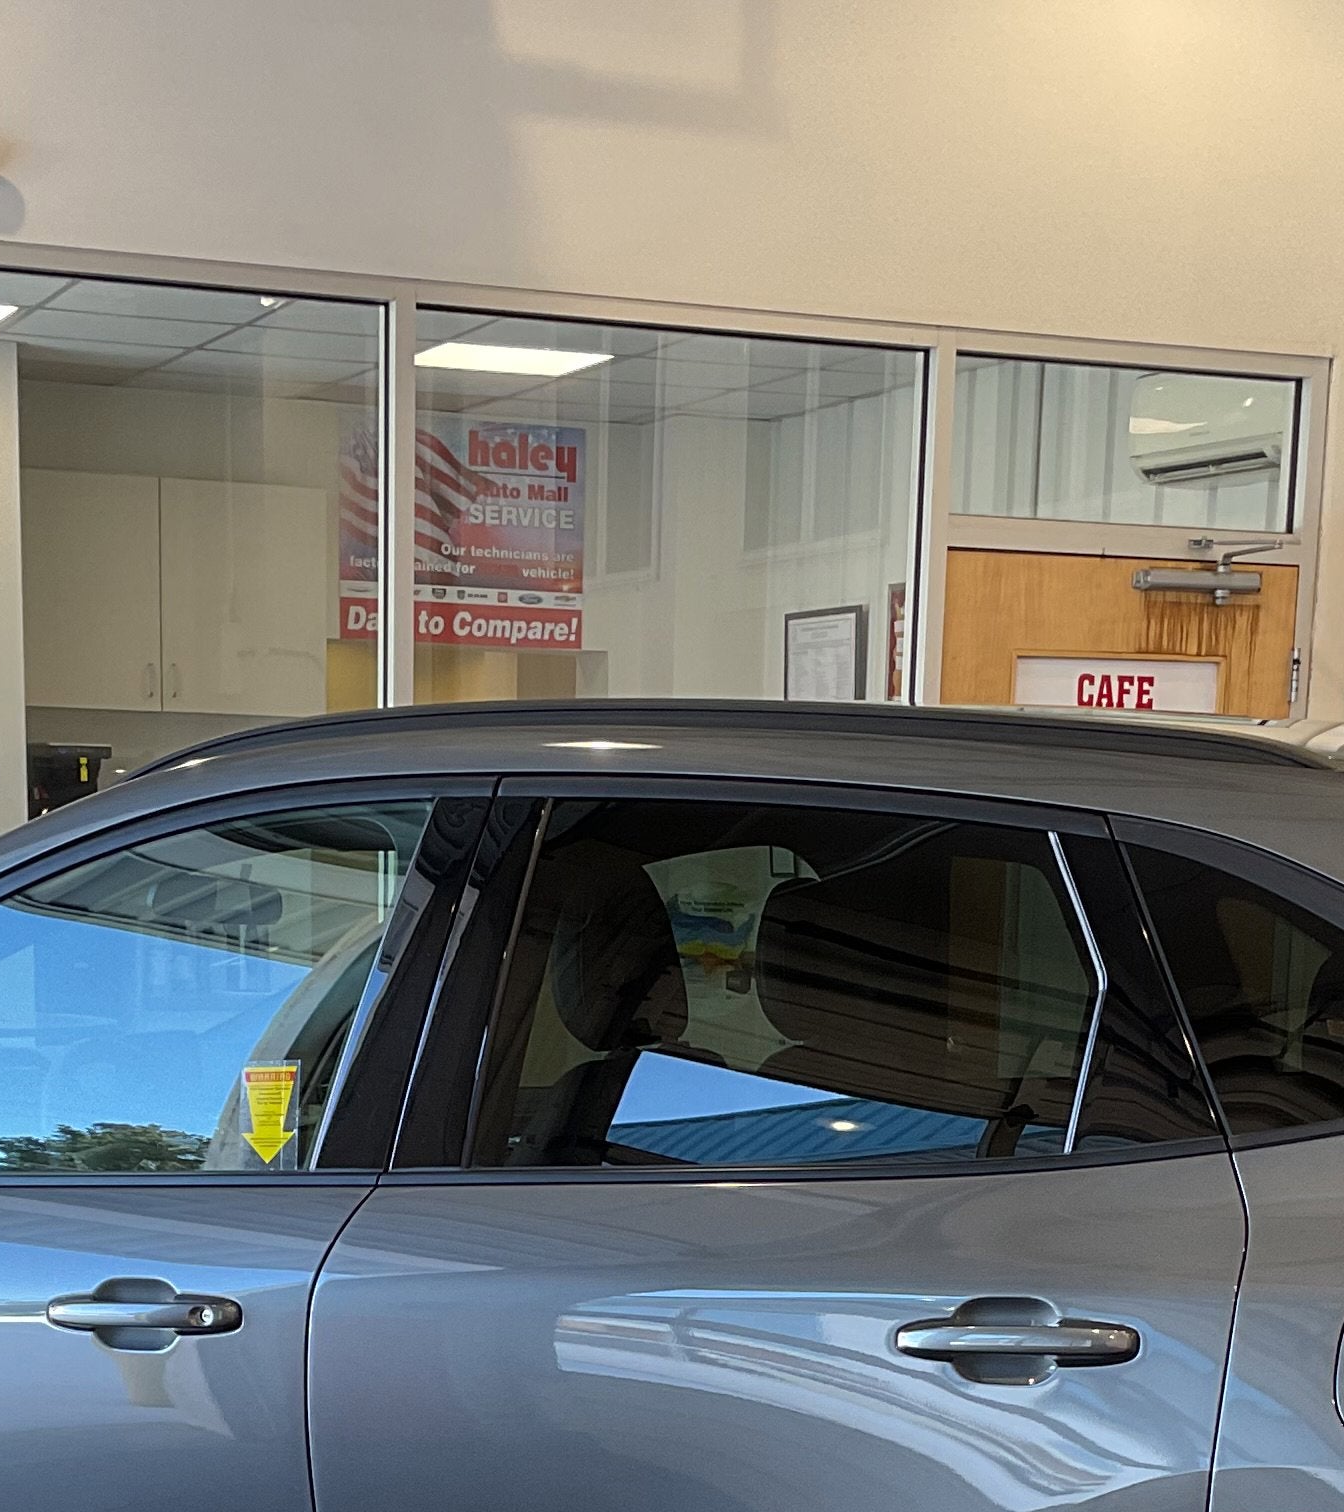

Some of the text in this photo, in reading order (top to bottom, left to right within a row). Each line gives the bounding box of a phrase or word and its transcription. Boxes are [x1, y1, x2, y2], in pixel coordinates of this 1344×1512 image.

[468, 430, 577, 483] haley
[527, 484, 569, 503] Mall
[468, 503, 575, 530] SERVICE
[441, 543, 574, 562] Our technicians are
[454, 561, 476, 575] for
[522, 566, 575, 580] vehicle!
[347, 605, 578, 644] Da to Compare!
[1077, 673, 1155, 710] CAFE
